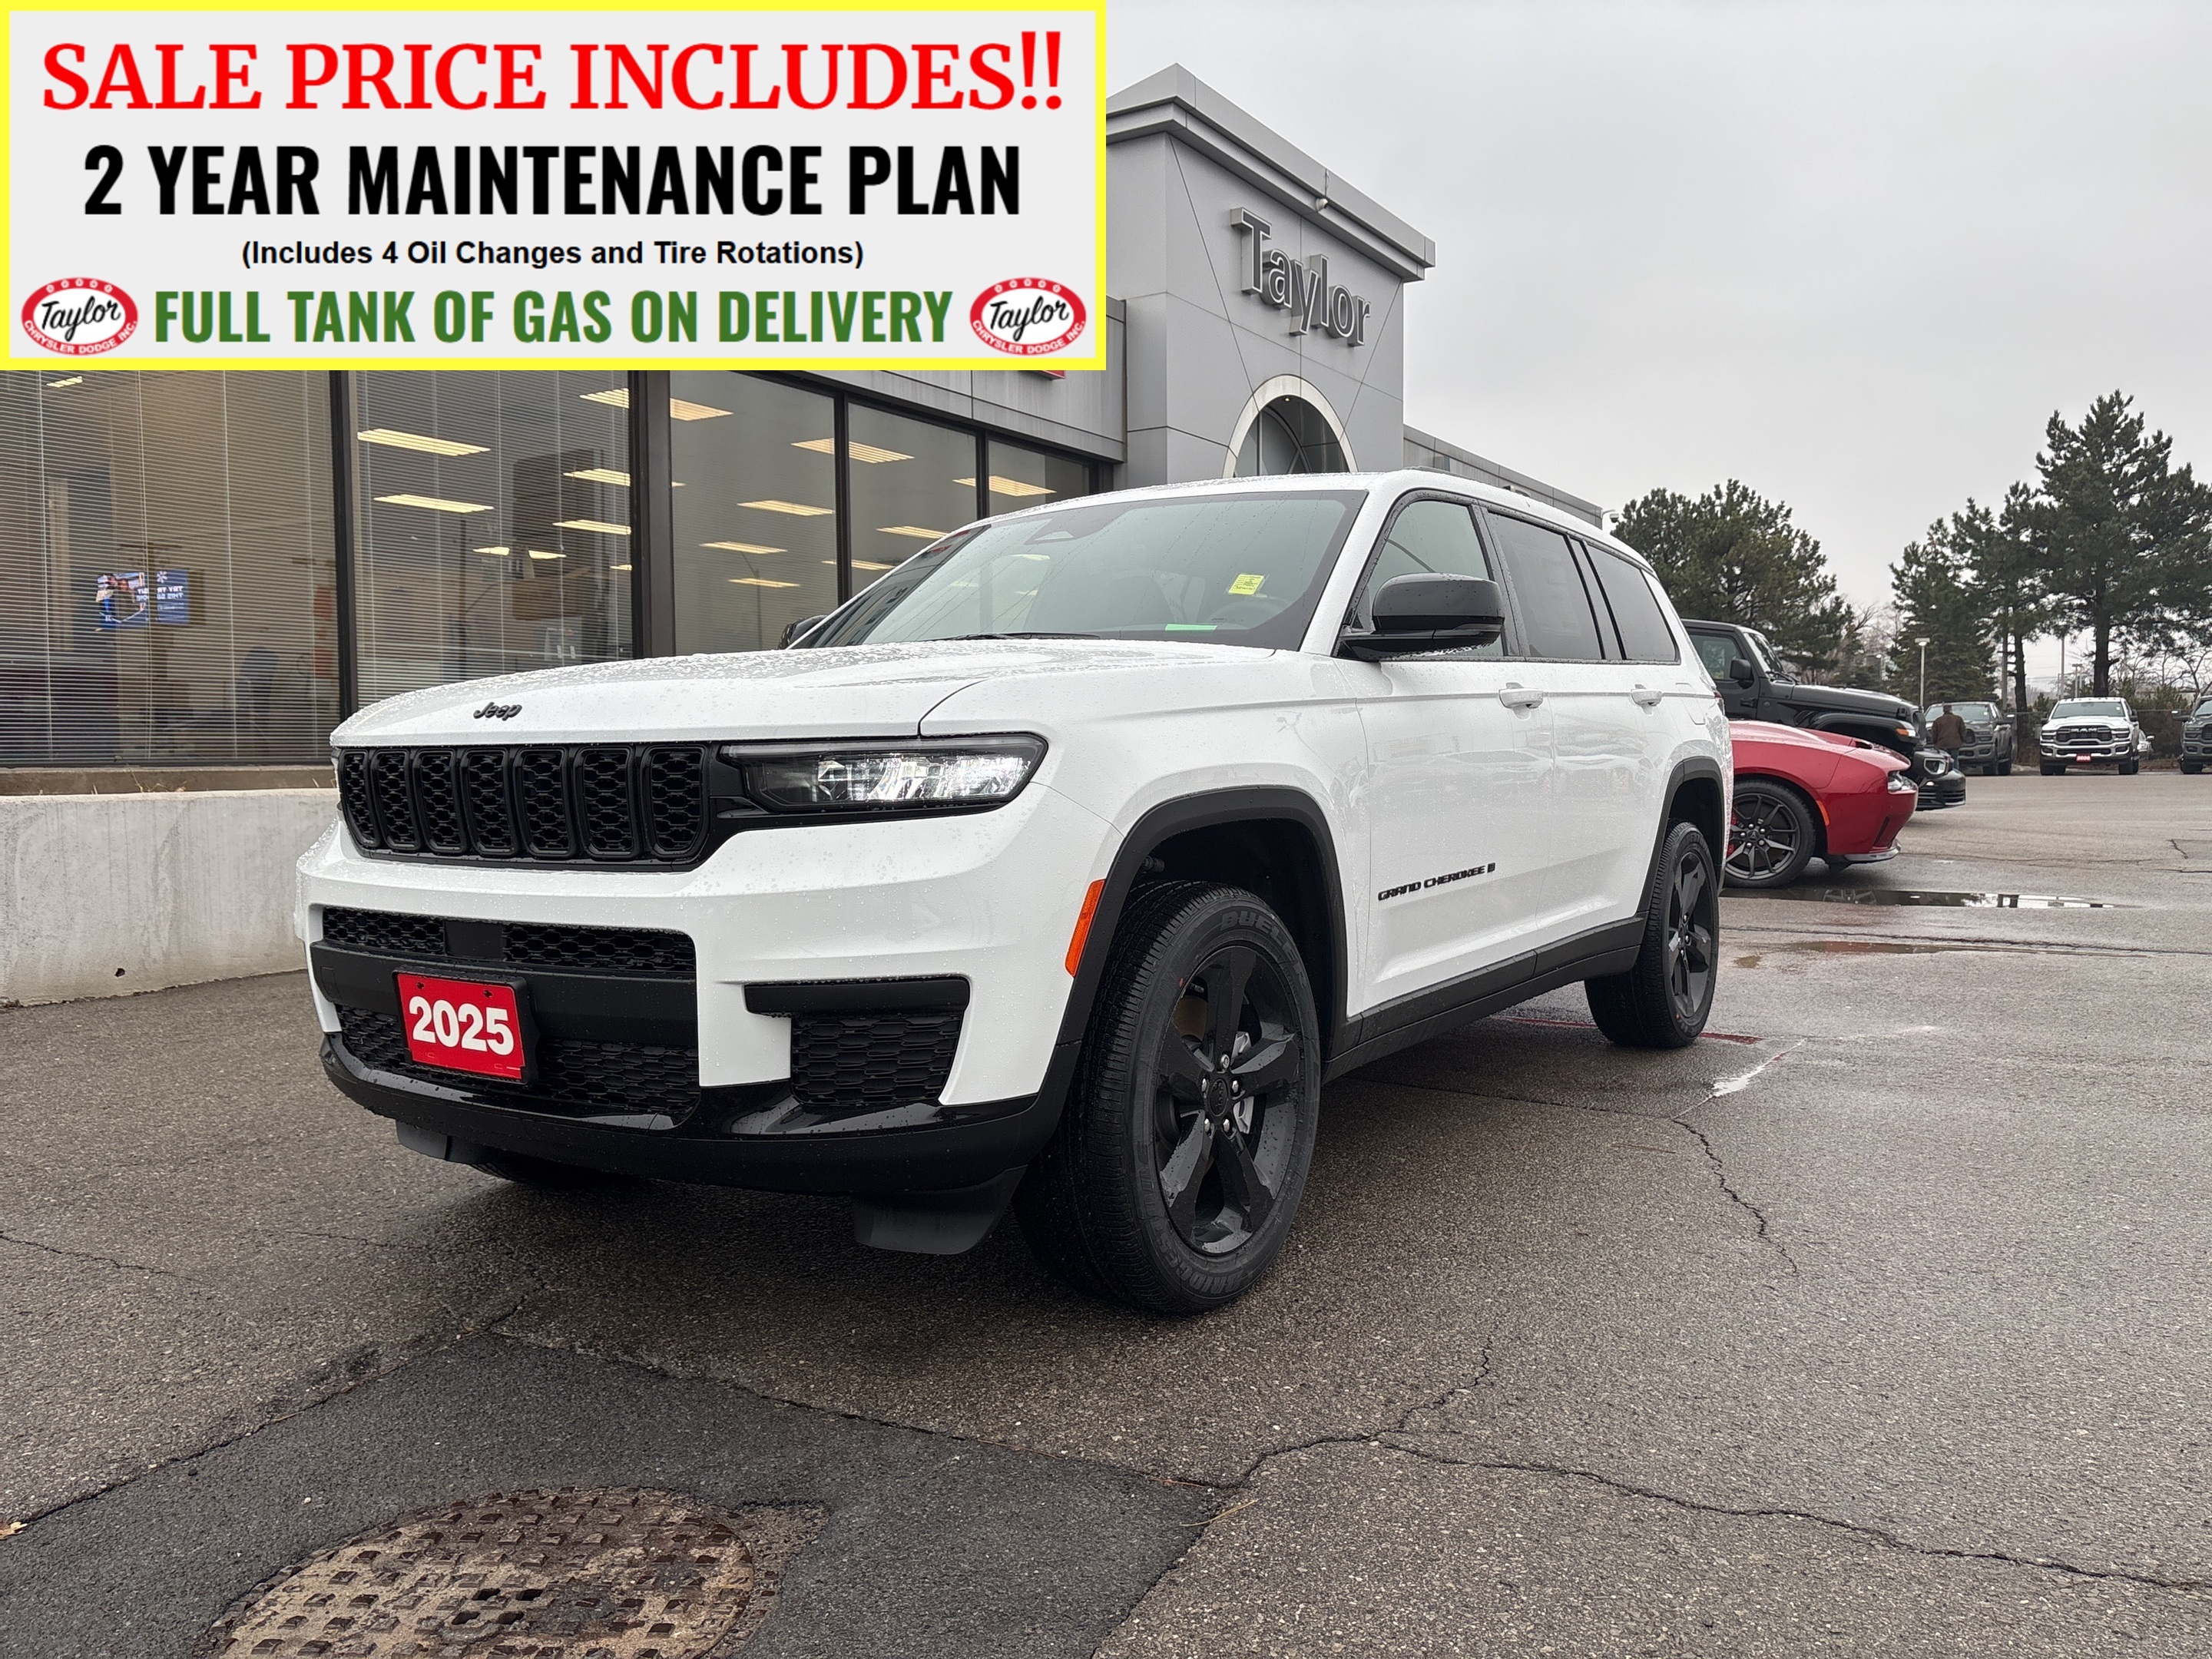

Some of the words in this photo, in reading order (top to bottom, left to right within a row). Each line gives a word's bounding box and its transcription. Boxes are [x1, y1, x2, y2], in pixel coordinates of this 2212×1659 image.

[1232, 207, 1371, 346] Taylor
[473, 701, 522, 721] Jeep
[1378, 881, 1422, 901] GRAND
[1424, 865, 1485, 889] CHEROKEE
[1220, 910, 1306, 989] DUELER
[409, 995, 515, 1056] 2025
